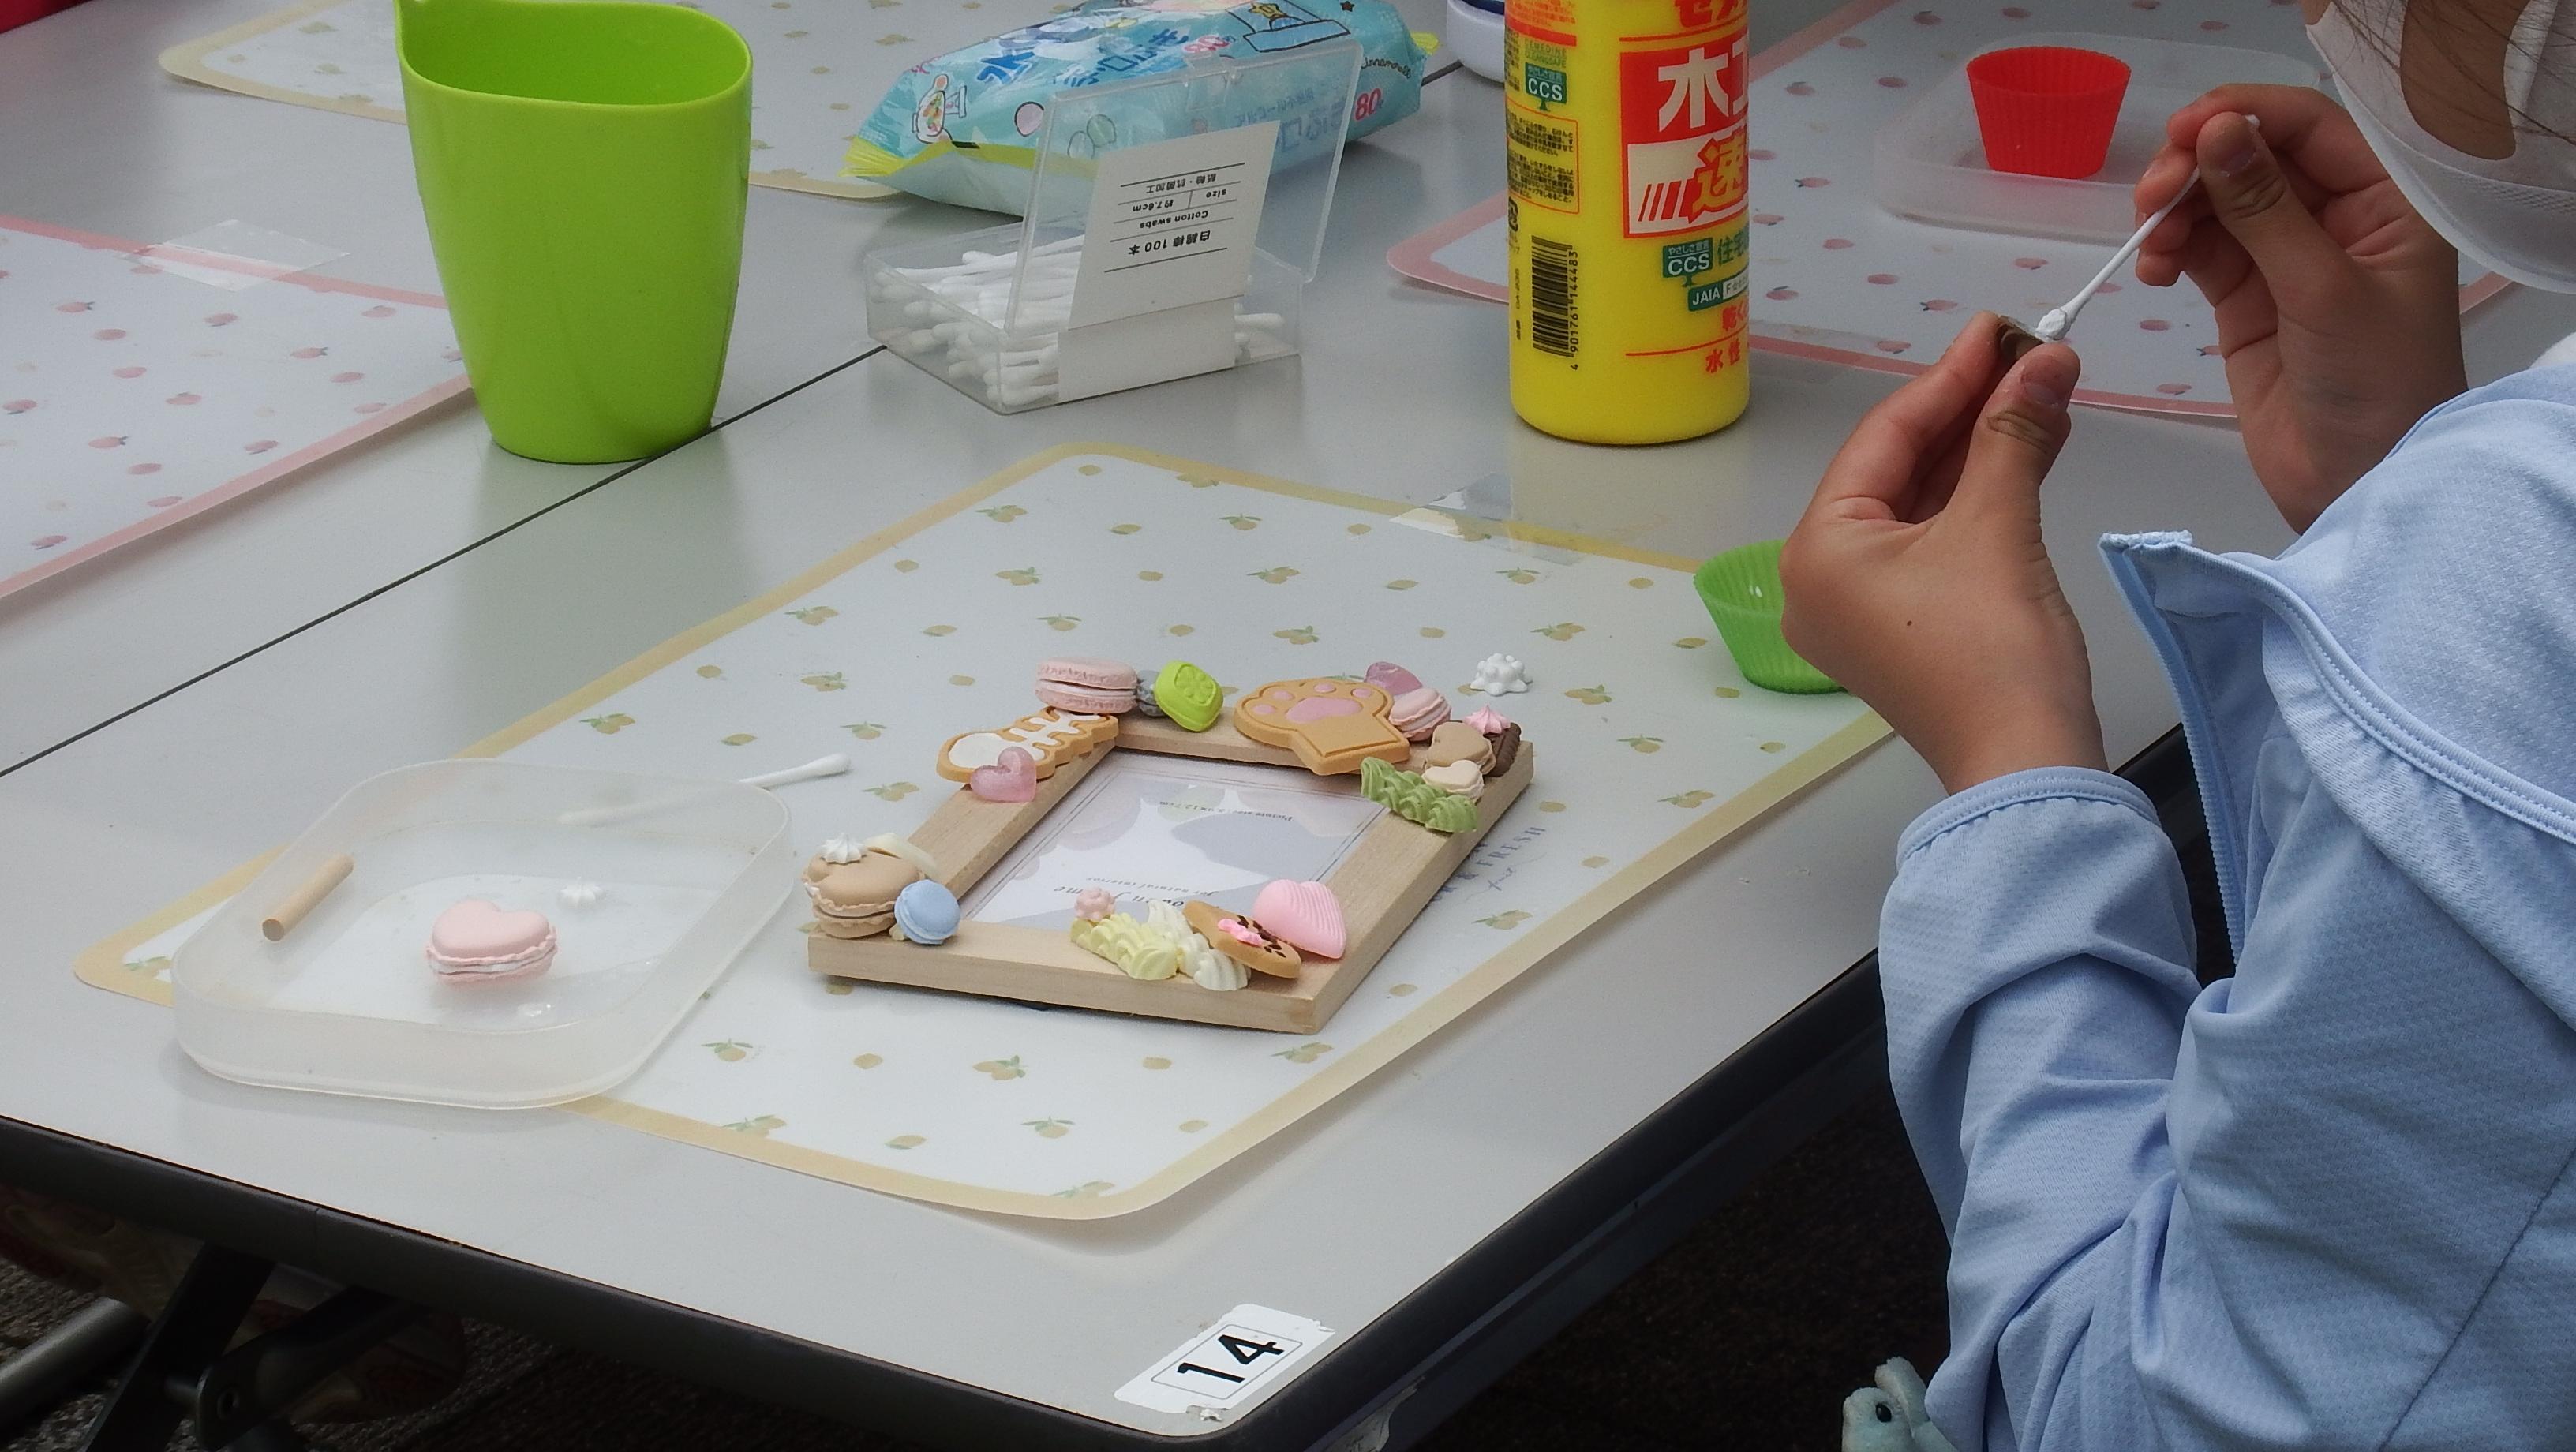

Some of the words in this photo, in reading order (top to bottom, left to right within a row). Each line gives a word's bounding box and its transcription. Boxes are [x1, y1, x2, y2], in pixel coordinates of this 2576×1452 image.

[1528, 77, 1563, 102] CCS
[1206, 189, 1227, 200] size
[1139, 216, 1171, 230] swabs
[1174, 210, 1209, 222] Cotton
[1668, 253, 1710, 276] CCS
[1692, 286, 1721, 306] JAIA
[1475, 826, 1547, 867] FRESH
[1085, 876, 1136, 887] interior
[1139, 882, 1189, 895] natural
[1176, 1333, 1285, 1383] 14
